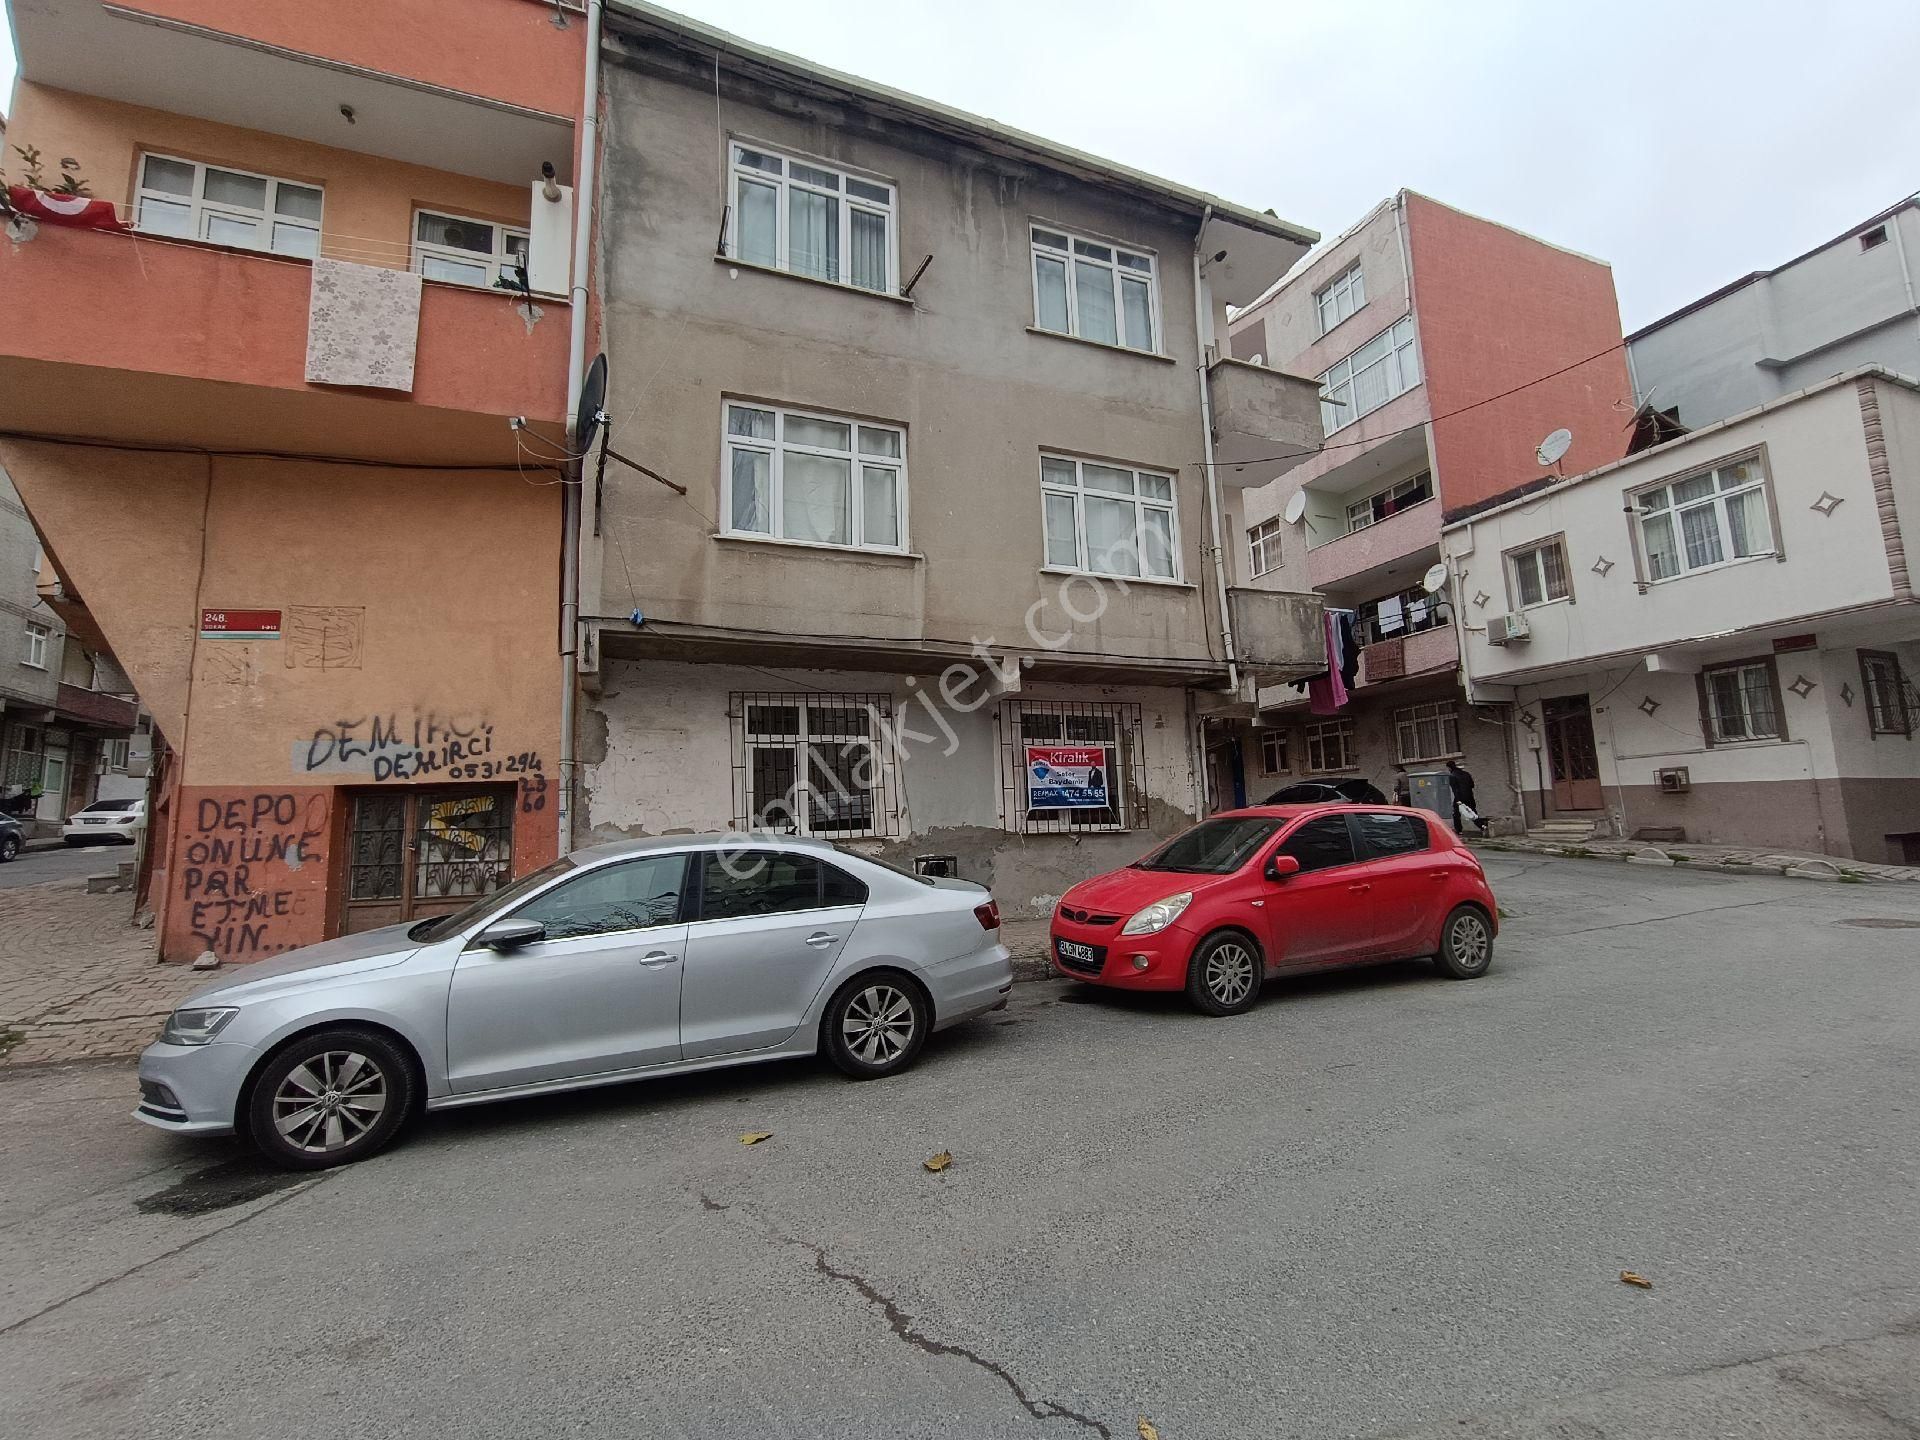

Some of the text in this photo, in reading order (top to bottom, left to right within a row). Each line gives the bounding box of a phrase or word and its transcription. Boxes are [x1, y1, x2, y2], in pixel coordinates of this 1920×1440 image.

[205, 613, 228, 623] 248.
[505, 752, 542, 772] 294
[1050, 751, 1090, 763] Kiralık
[518, 774, 548, 793] 23
[198, 794, 297, 834] DEPO
[184, 863, 250, 900] PAR
